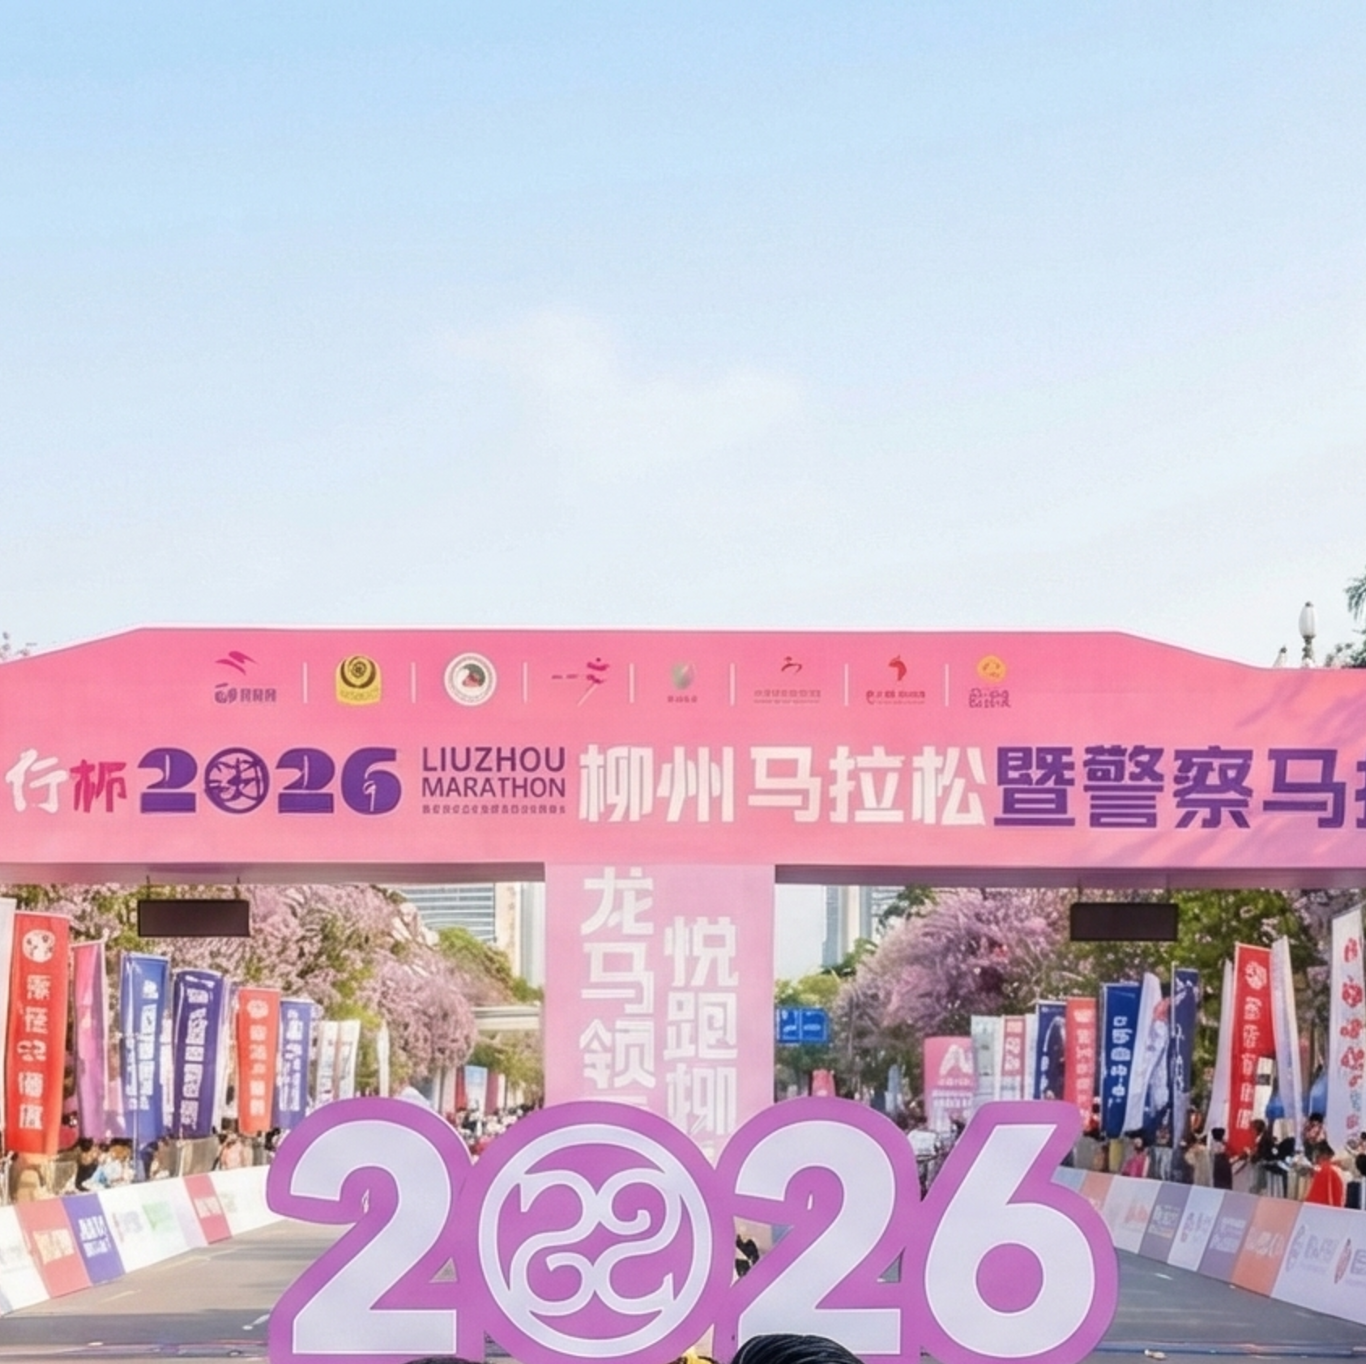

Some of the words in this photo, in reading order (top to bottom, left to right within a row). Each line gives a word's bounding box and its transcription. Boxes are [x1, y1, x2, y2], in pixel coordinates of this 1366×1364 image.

[421, 776, 566, 799] MARATHON
[422, 746, 566, 773] LIUZHOU
[579, 867, 656, 1108] 龙马领
[663, 915, 738, 1155] 悦跑柳
[287, 1118, 1096, 1359] 2026
